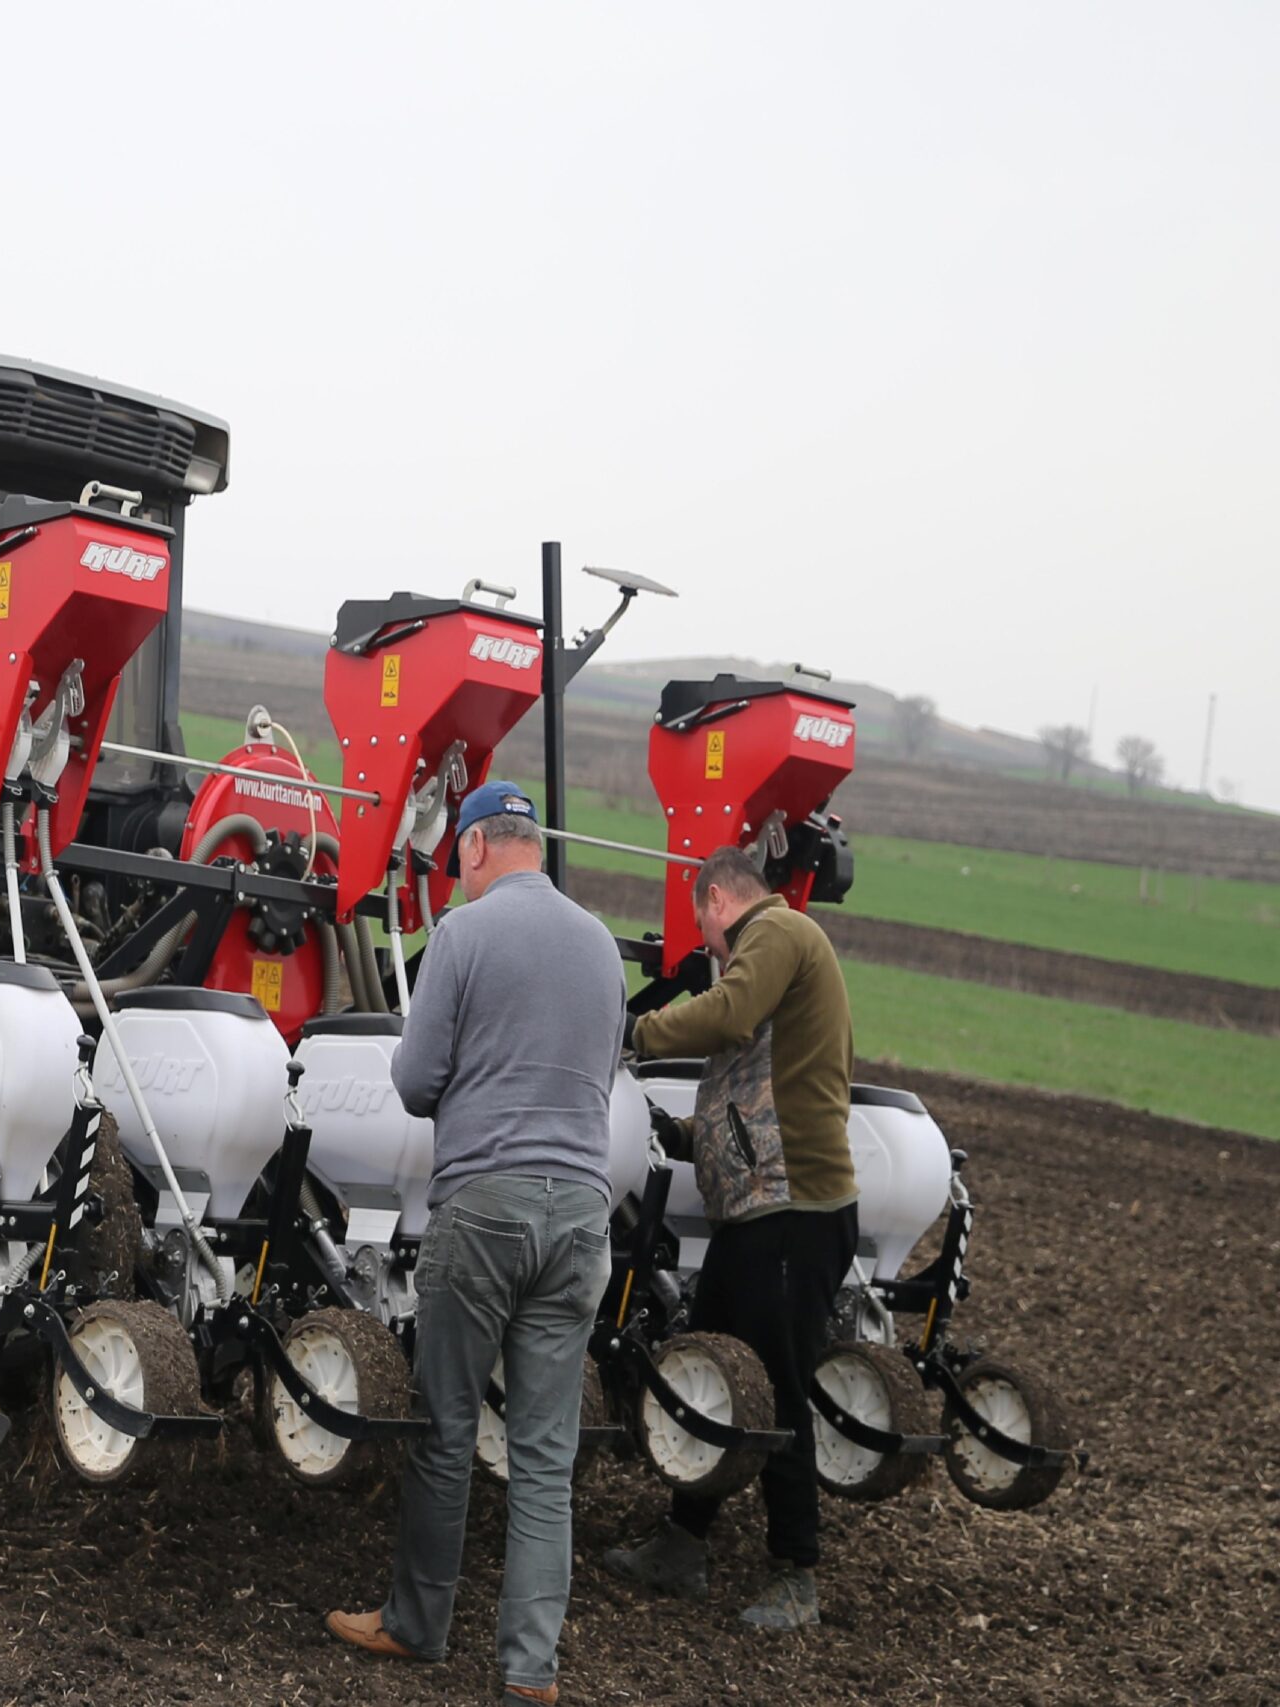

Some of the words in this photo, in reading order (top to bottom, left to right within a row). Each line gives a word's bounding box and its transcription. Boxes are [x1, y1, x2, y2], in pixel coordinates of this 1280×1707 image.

[81, 542, 166, 580] KURT
[470, 633, 540, 669] KURT
[794, 713, 853, 747] KURT
[235, 777, 322, 812] www.kurttarim.cm
